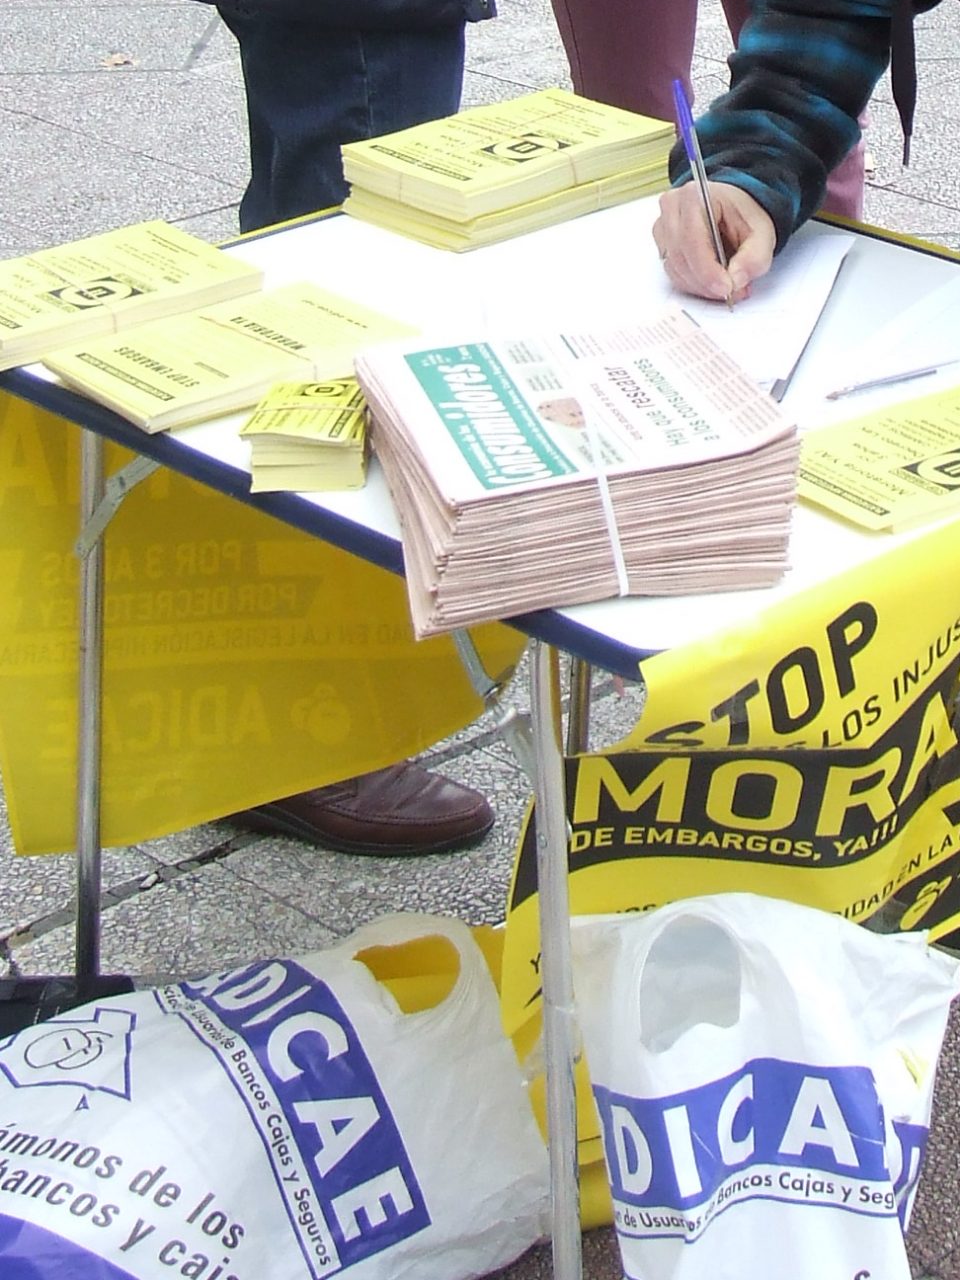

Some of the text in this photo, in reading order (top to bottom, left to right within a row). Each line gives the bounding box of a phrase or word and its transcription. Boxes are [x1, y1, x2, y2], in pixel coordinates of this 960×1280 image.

[604, 366, 690, 447] Hay que rescatar
[633, 358, 699, 420] consumidores
[438, 363, 553, 485] Consumidores
[689, 419, 713, 436] los
[644, 600, 878, 746] STOP
[821, 695, 882, 748] LOS
[569, 814, 898, 861] DE EMBARGOS, YA!!!
[928, 833, 953, 861] LA
[231, 1048, 271, 1111] Bancos
[265, 1114, 293, 1167] Cajas
[293, 1188, 331, 1267] Seguros
[600, 1073, 891, 1199] DICA
[128, 1165, 182, 1208] de
[185, 1192, 245, 1250] los
[717, 1173, 773, 1204] Bancos
[778, 1172, 835, 1197] Cajas
[840, 1186, 853, 1204] y
[858, 1186, 895, 1209] Seg
[119, 1218, 156, 1252] y
